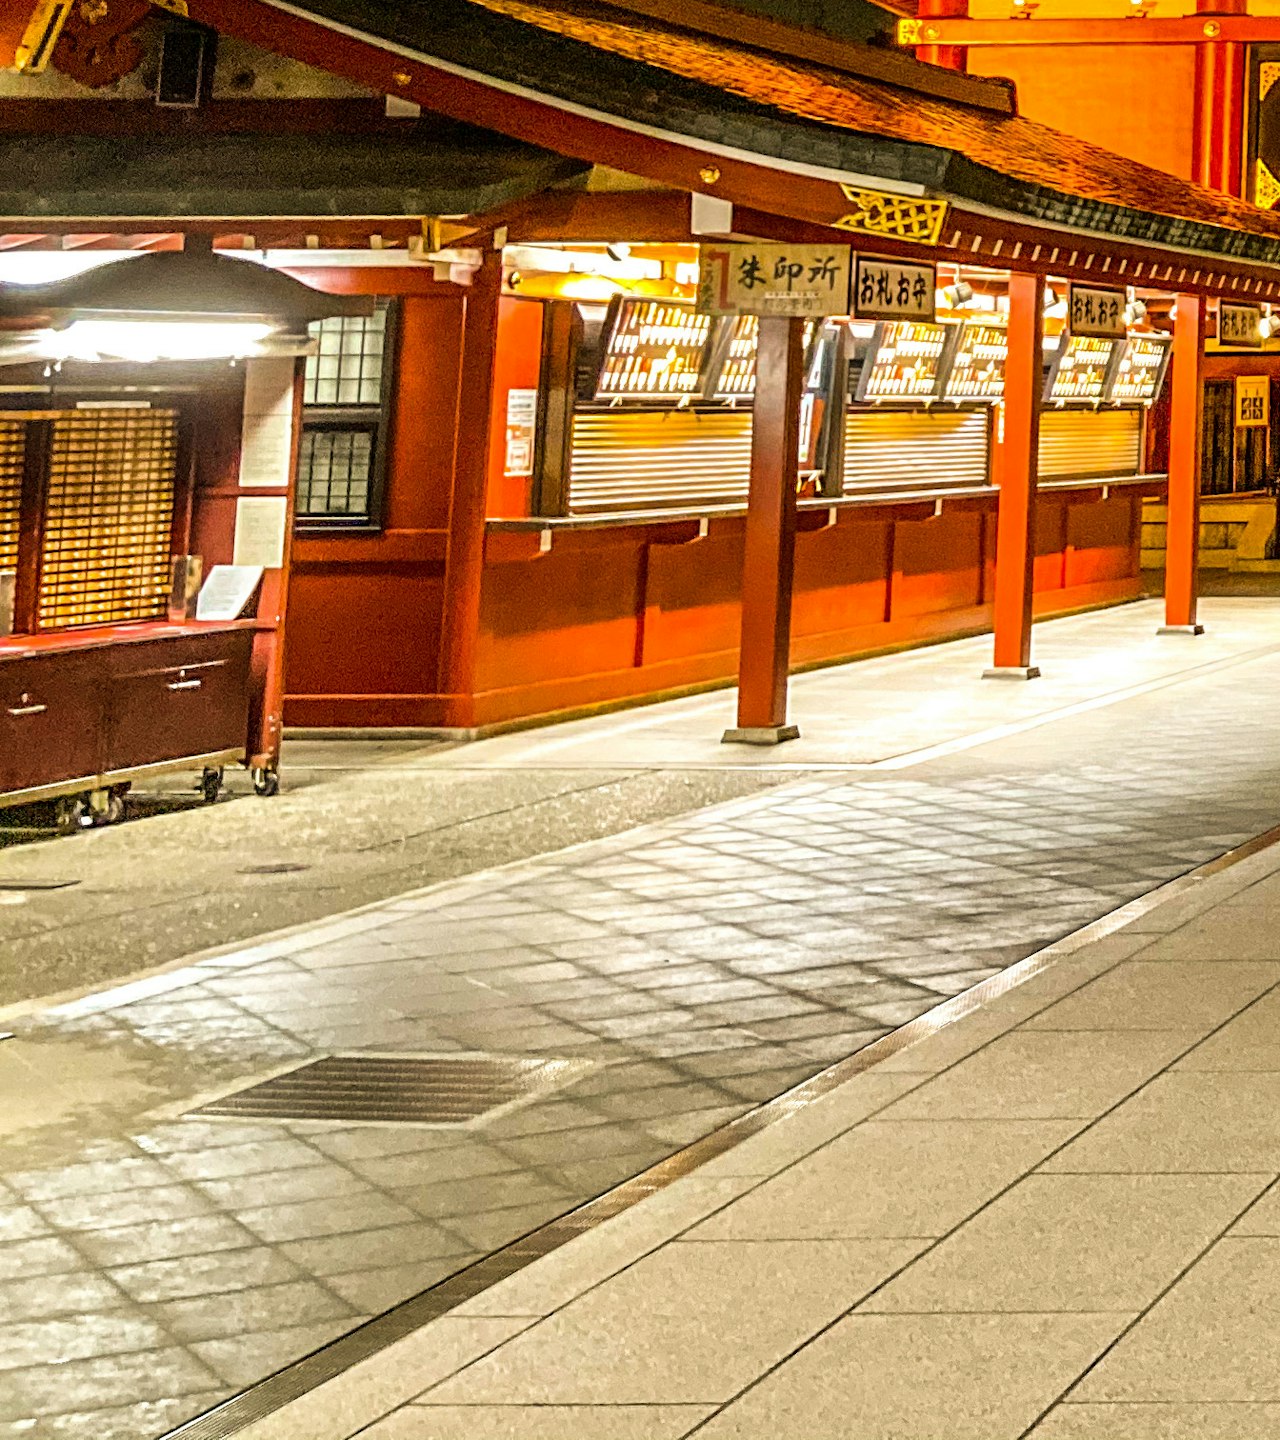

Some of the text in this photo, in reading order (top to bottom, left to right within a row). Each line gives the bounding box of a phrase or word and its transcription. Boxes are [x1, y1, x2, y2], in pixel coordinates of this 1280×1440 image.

[738, 255, 842, 291] 朱印所
[861, 267, 927, 310] お札お守
[1074, 294, 1119, 329] お札お守
